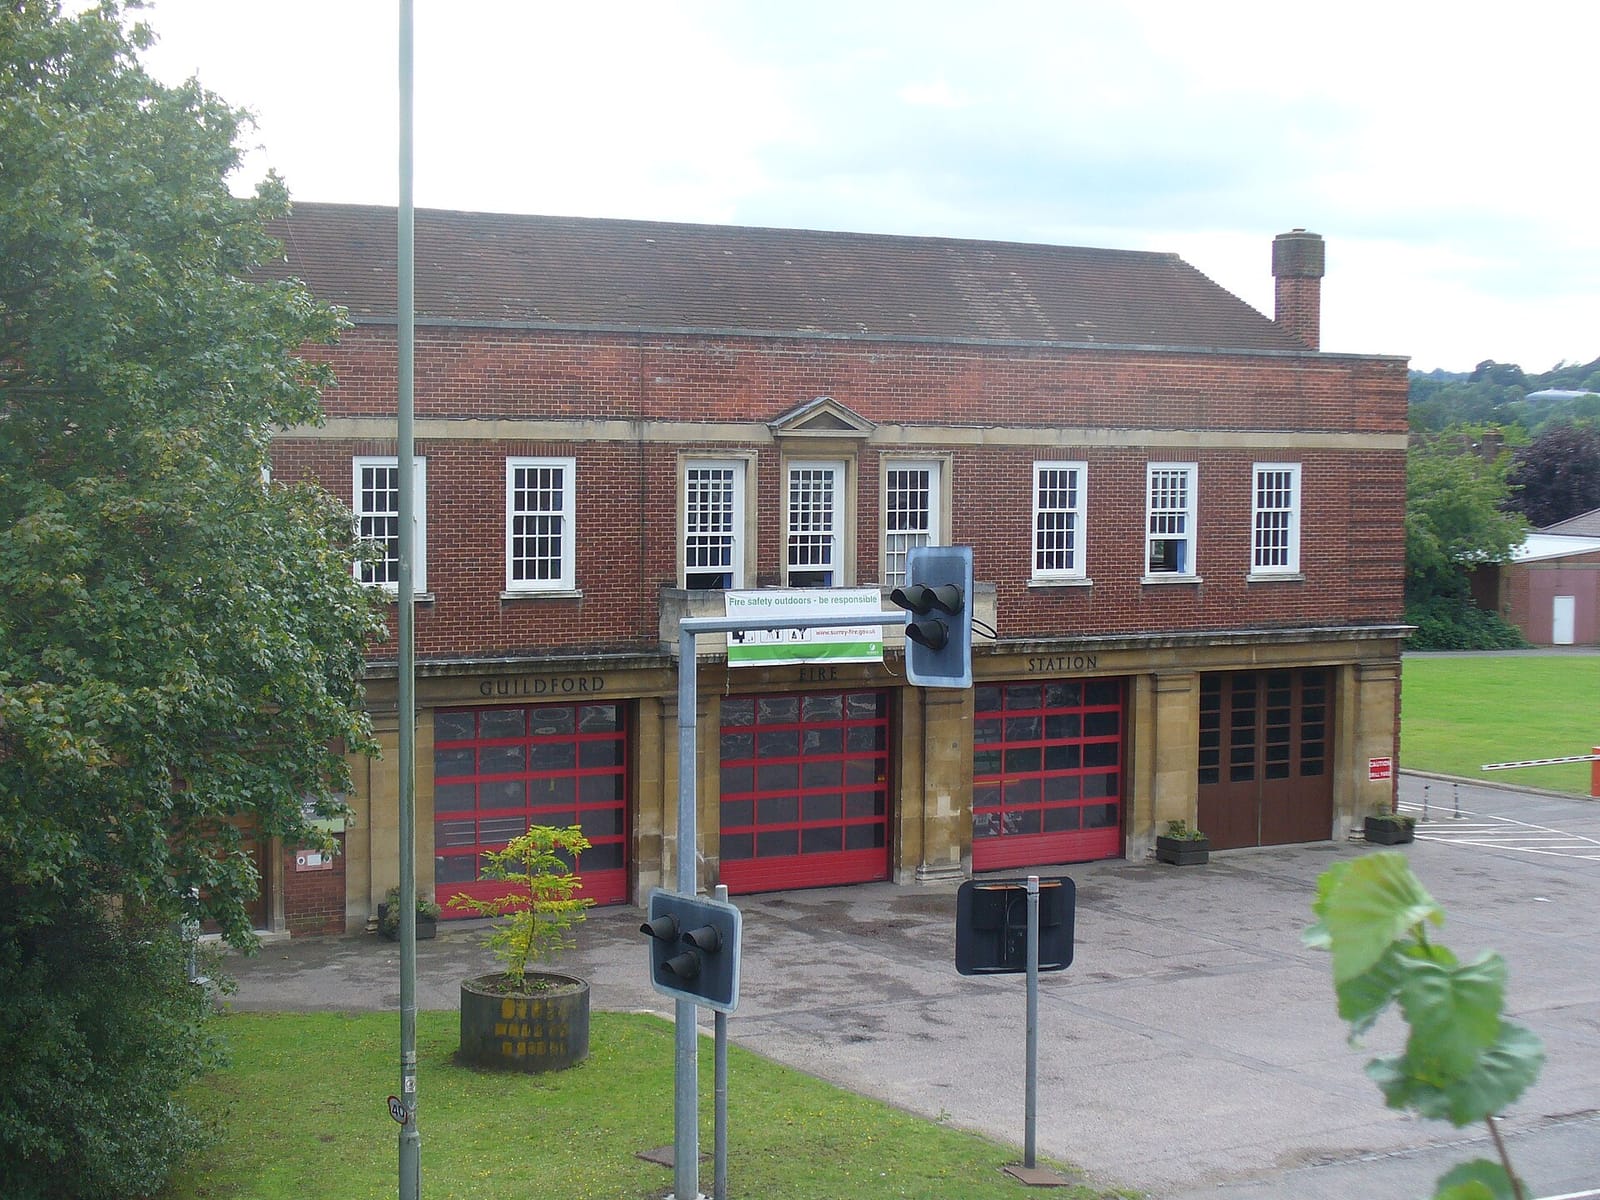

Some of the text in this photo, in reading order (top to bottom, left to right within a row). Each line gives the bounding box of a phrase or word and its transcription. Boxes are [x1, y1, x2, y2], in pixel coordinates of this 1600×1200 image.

[729, 597, 746, 606] Fire
[747, 596, 773, 607] safety
[774, 596, 812, 605] outdoors
[818, 596, 829, 604] be
[831, 595, 878, 606] responsible
[1028, 655, 1097, 672] STATION
[799, 667, 837, 680] FIRE
[480, 676, 605, 696] GUILDFORD
[392, 1104, 404, 1117] 40
